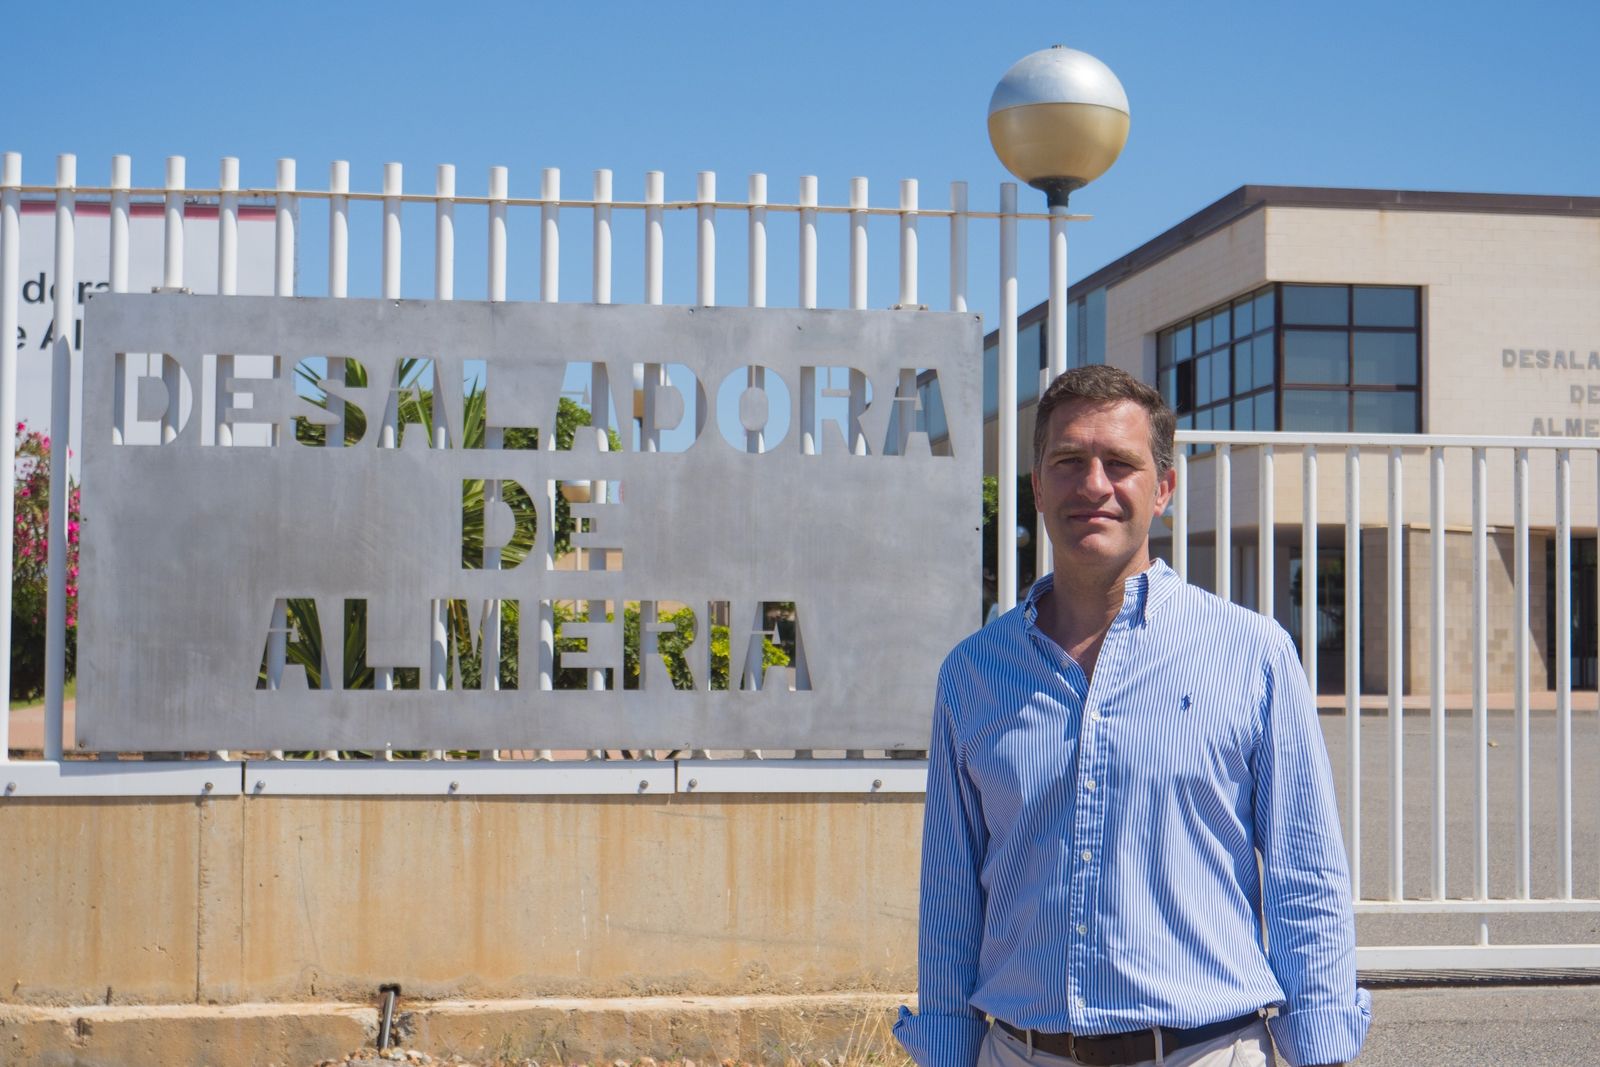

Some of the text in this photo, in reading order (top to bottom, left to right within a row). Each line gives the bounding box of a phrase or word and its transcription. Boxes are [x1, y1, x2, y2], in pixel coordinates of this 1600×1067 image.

[1502, 349, 1600, 370] DESALA
[112, 352, 955, 457] DESALADORA
[1569, 384, 1600, 405] DE
[1531, 418, 1600, 437] ALME
[461, 478, 624, 571] DE
[255, 598, 813, 690] ALMERIA
